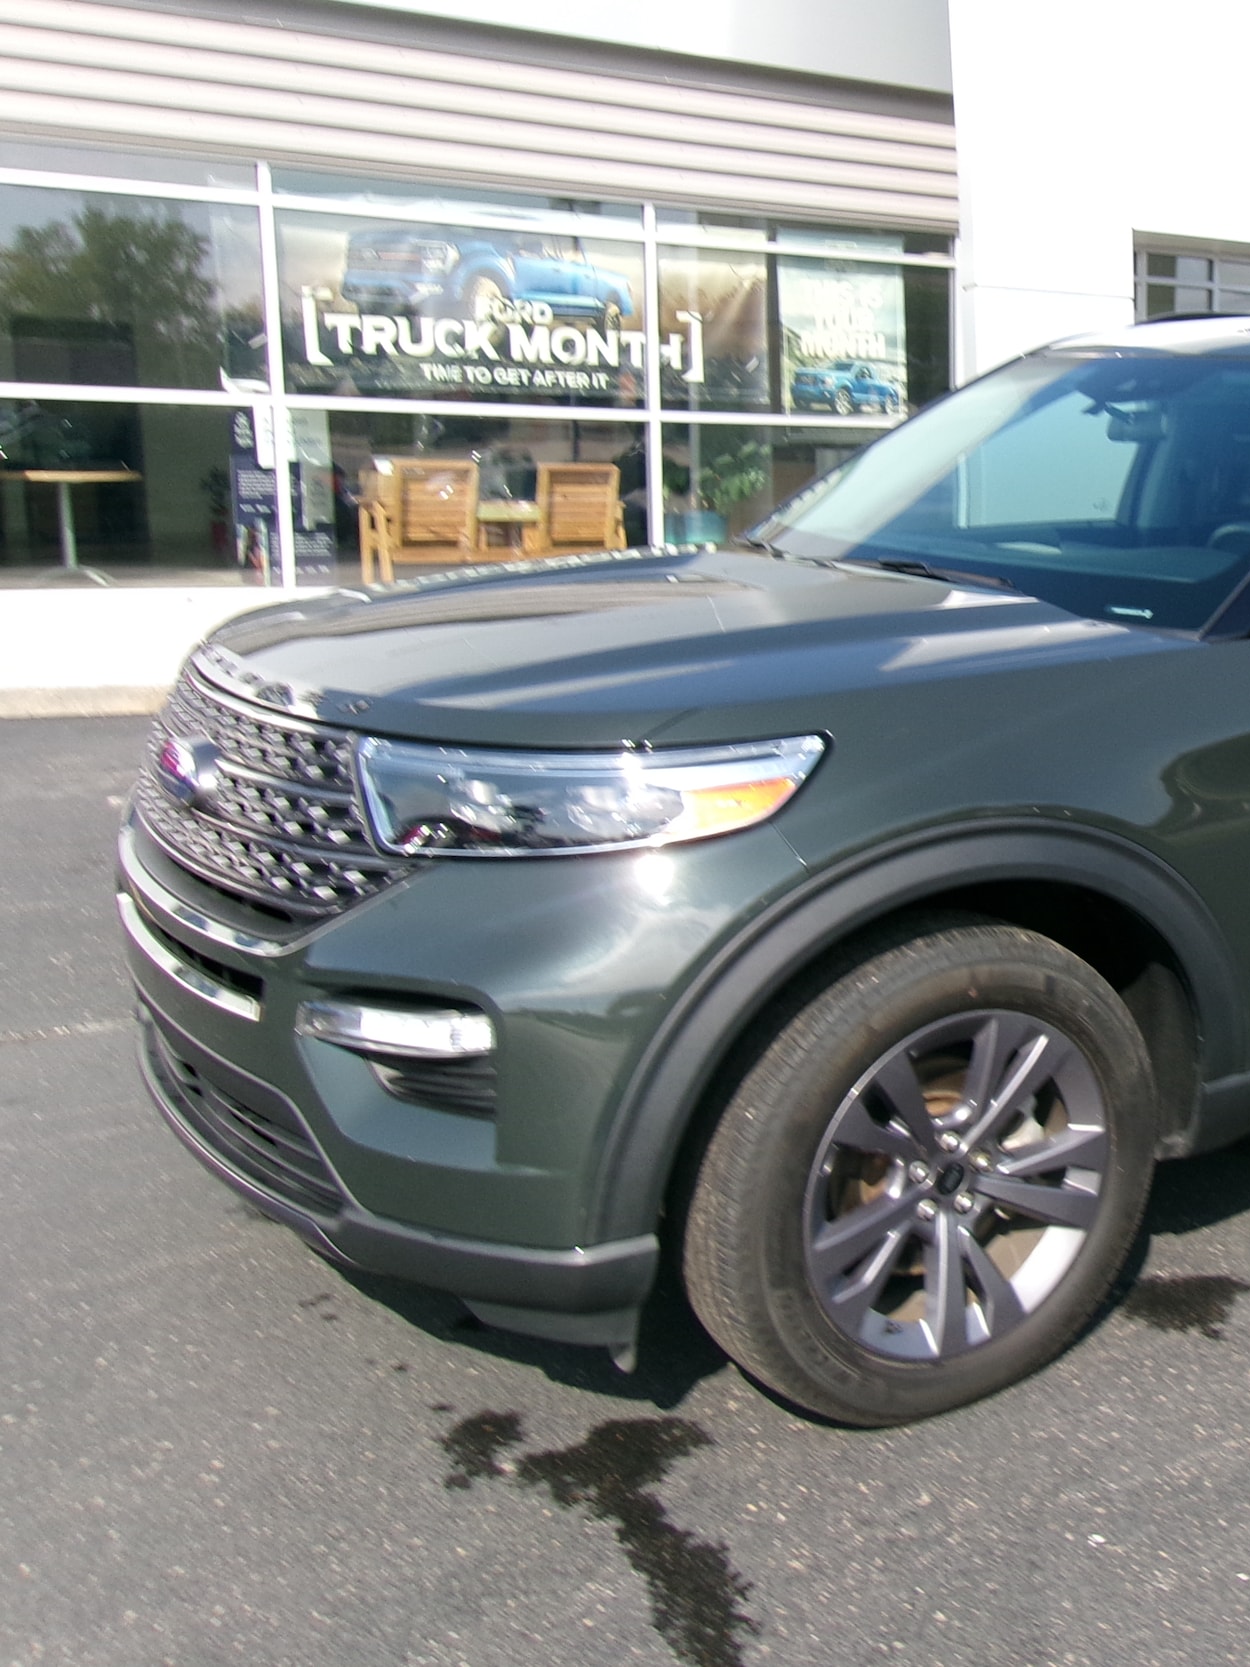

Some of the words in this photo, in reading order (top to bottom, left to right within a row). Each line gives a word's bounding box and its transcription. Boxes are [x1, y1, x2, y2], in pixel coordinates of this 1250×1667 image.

[474, 295, 553, 325] FORD
[323, 312, 501, 361] TRUCK
[420, 362, 463, 383] TIME
[464, 365, 493, 385] TO
[493, 367, 531, 387] GET
[532, 369, 591, 390] AFTER
[591, 371, 610, 391] IT
